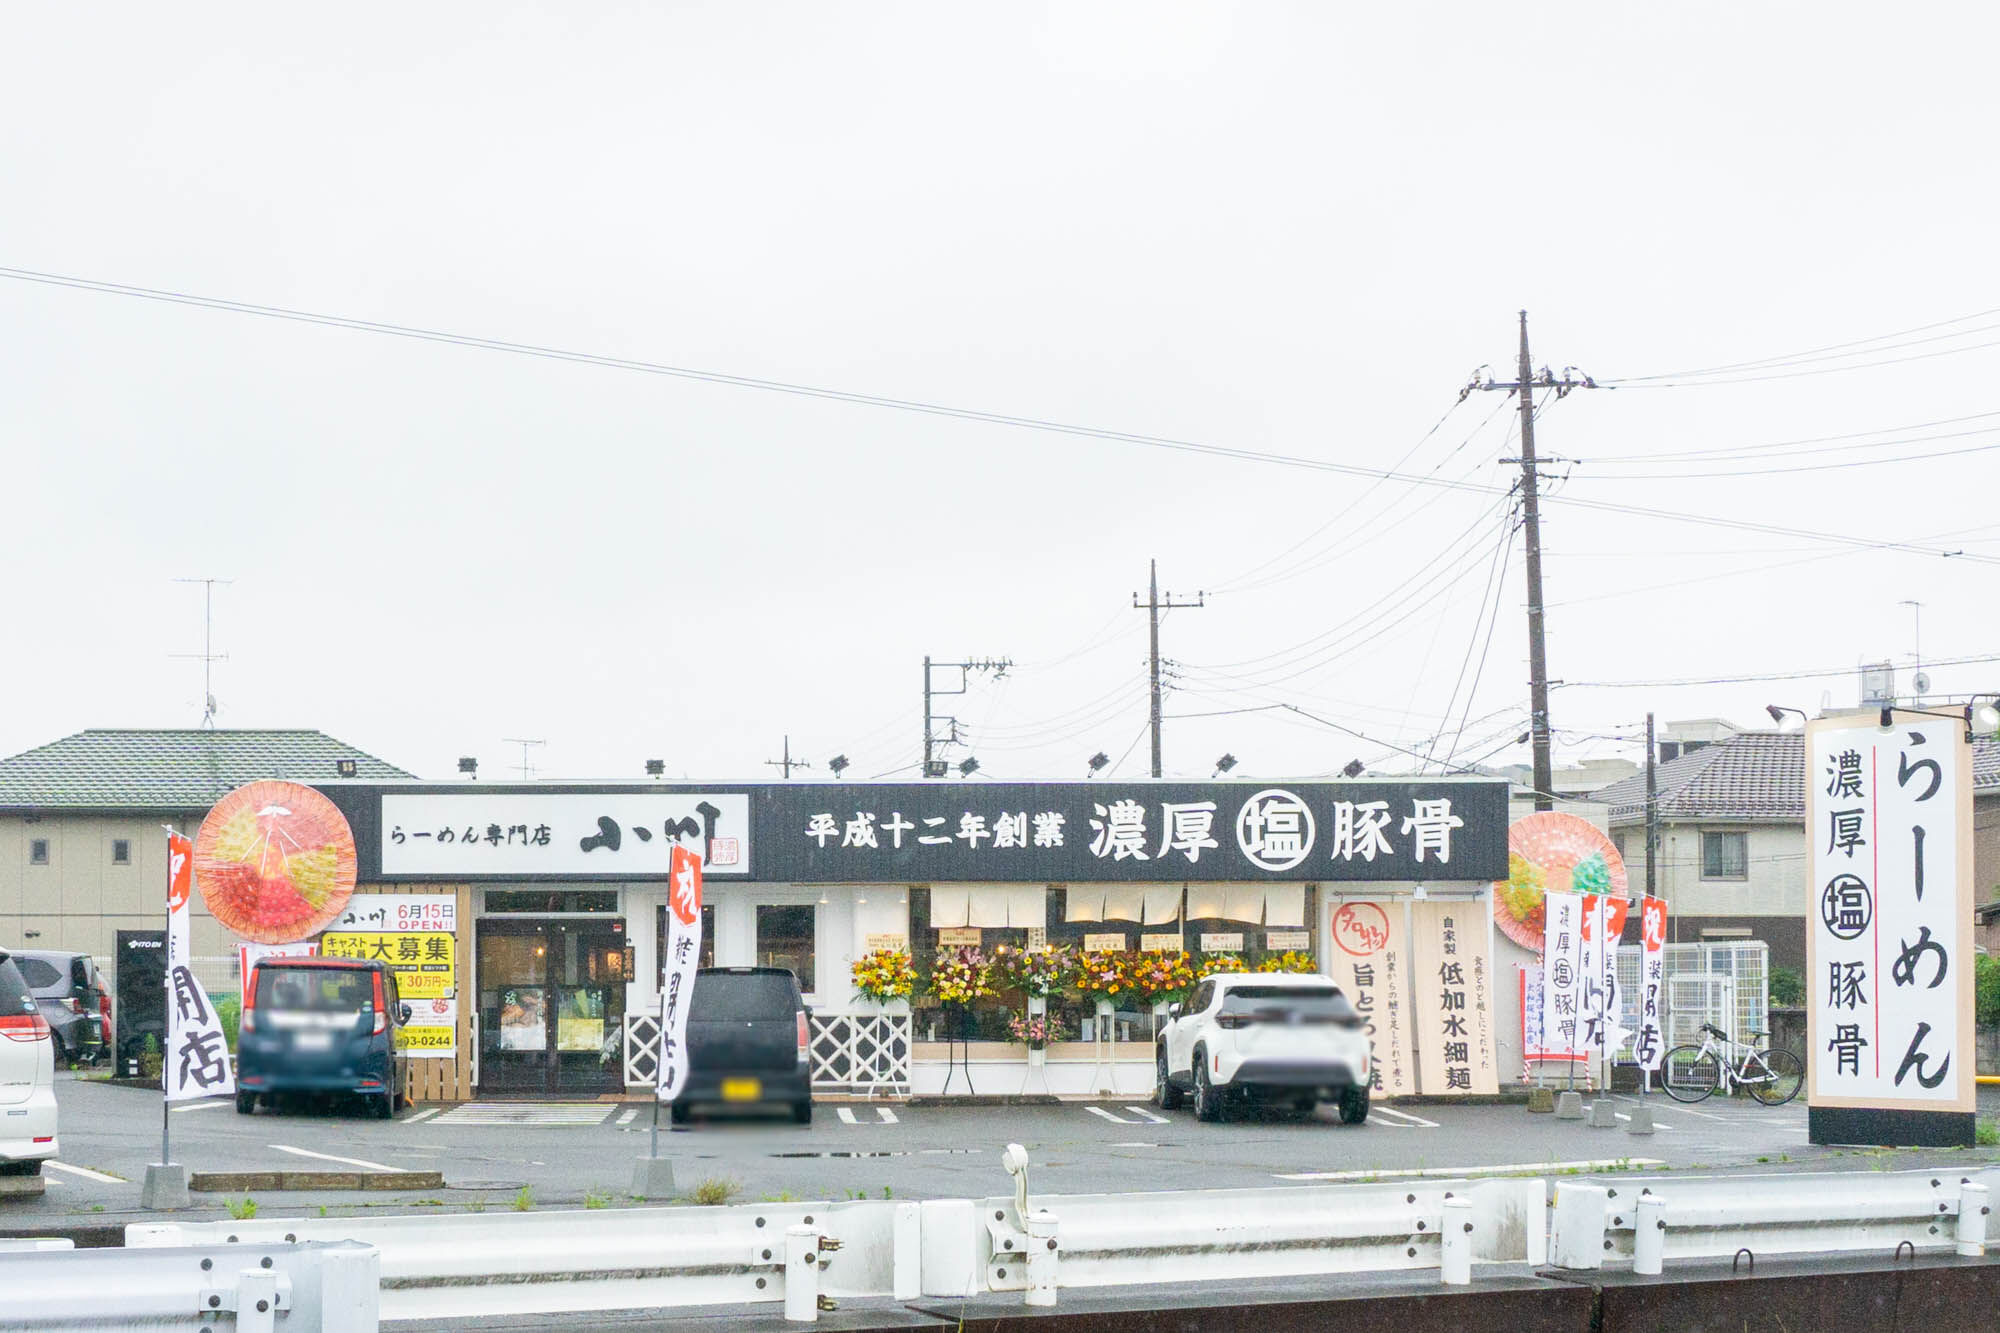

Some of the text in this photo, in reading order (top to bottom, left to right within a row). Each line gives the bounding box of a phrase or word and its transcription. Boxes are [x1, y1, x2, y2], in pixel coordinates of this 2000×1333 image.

[390, 822, 552, 847] らーめん専門店
[804, 811, 1067, 849] 平成十二年創業
[1088, 788, 1466, 872] 濃厚塩豚骨
[397, 904, 454, 919] 6月15日
[1339, 907, 1386, 951] 名物
[1644, 906, 1662, 944] 祝
[1821, 747, 1873, 1078] 濃厚塩豚骨
[1891, 731, 1951, 1090] らーめん
[327, 936, 367, 948] キャスト
[370, 937, 449, 961] 大募集
[1438, 916, 1472, 1090] 自家製 低加水細麺
